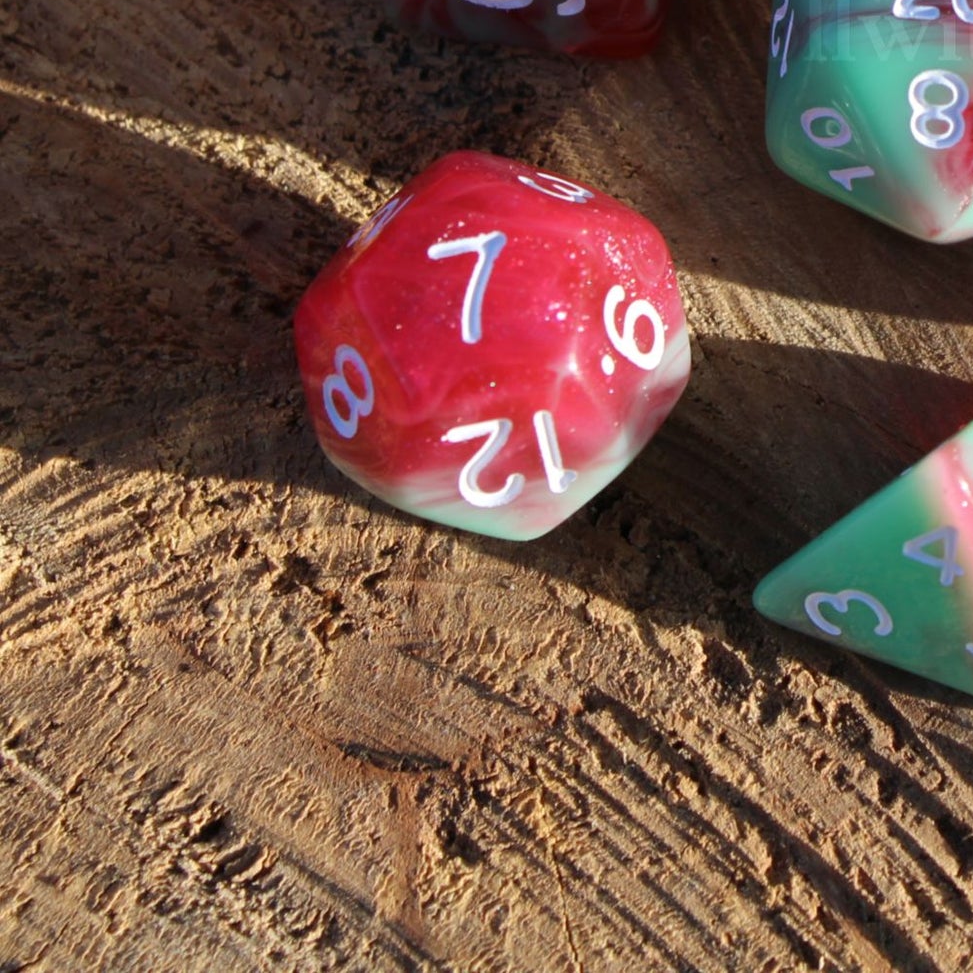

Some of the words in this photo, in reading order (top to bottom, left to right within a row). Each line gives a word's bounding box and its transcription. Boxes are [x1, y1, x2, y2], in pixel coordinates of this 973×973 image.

[801, 107, 875, 191] 10
[908, 69, 969, 149] 8
[427, 231, 507, 344] 7
[323, 344, 374, 438] 8
[440, 410, 579, 508] 12
[902, 524, 964, 587] 4
[804, 589, 893, 636] 3
